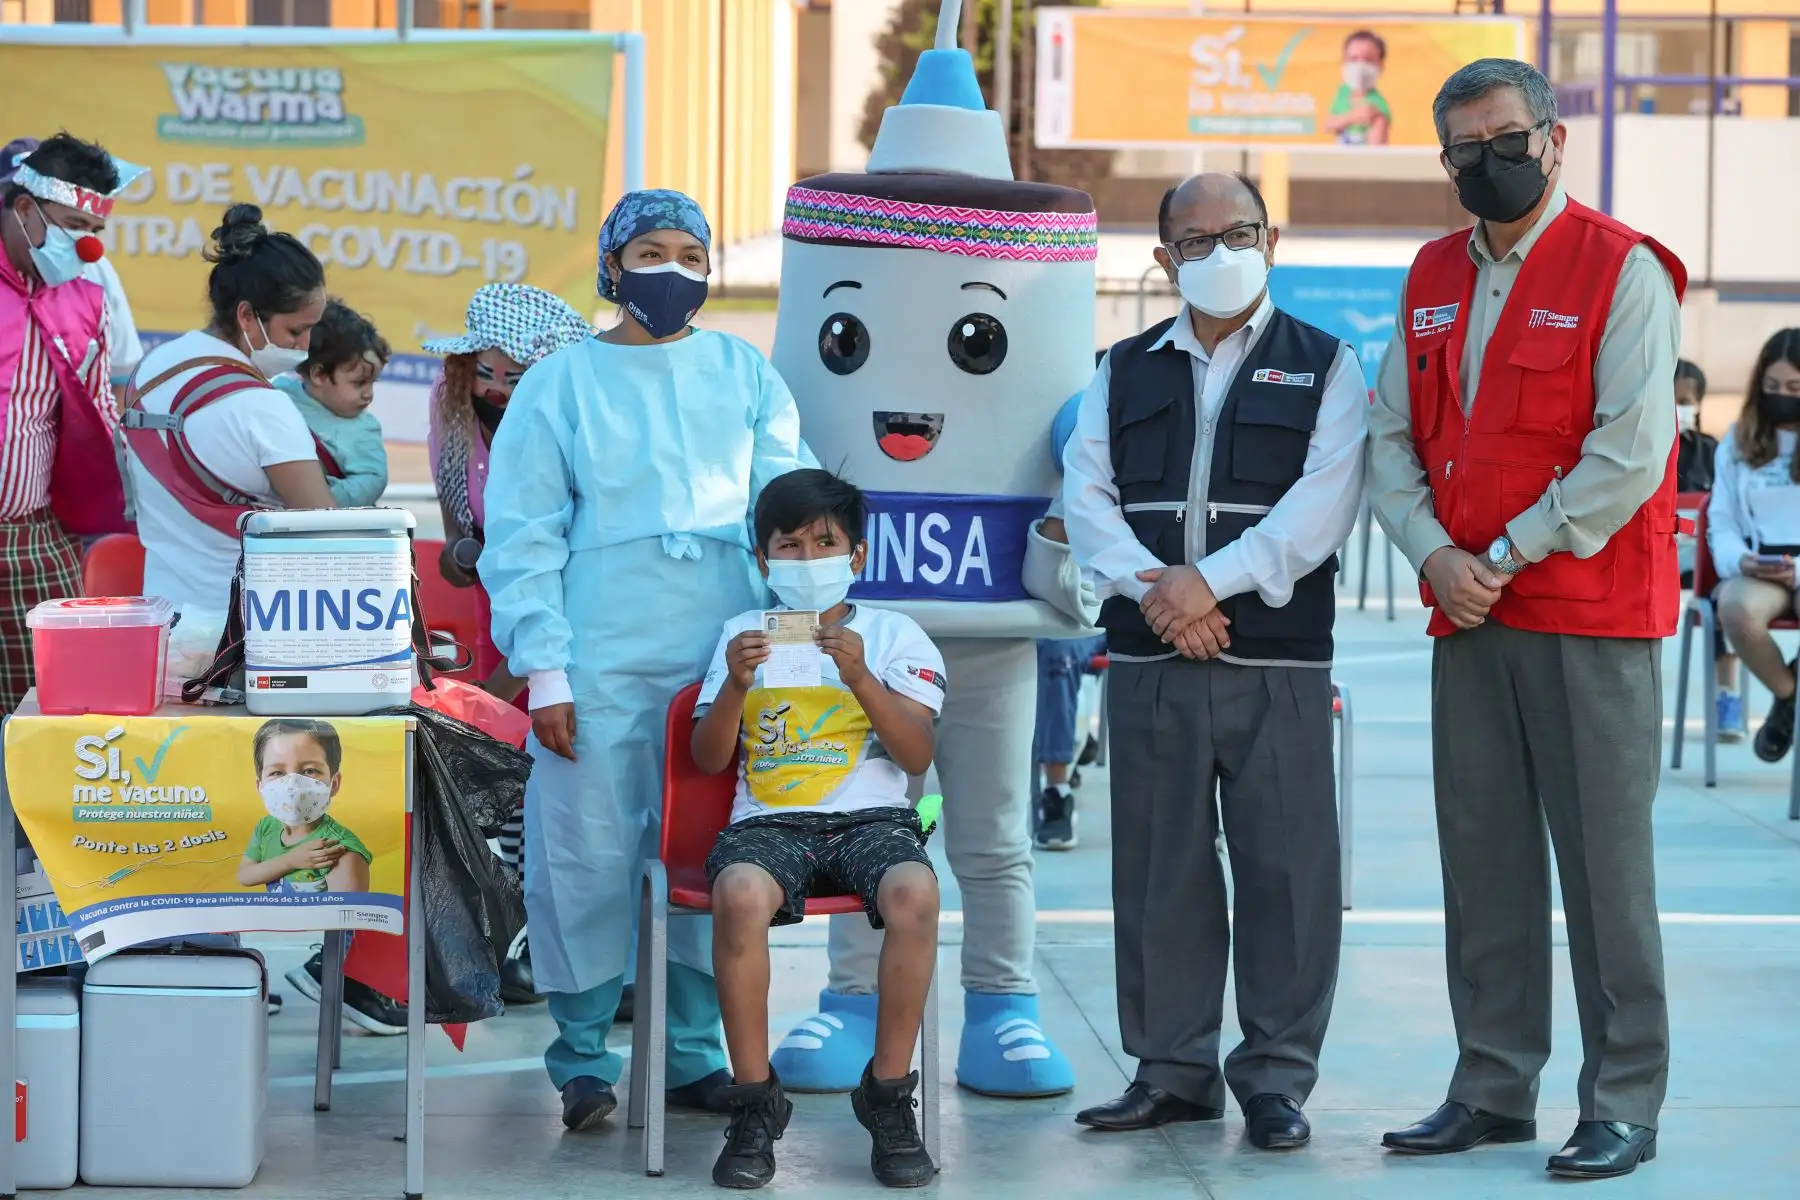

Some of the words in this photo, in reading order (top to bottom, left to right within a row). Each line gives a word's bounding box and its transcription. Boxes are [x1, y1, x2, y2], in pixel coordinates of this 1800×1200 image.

[172, 87, 346, 122] Warma
[166, 162, 233, 206] DE
[243, 163, 578, 232] VACUNACIÓN
[300, 222, 529, 282] COVID-19
[855, 512, 993, 587] INSA
[246, 588, 412, 632] MINSA
[74, 725, 131, 785] Sí,
[73, 784, 113, 804] me
[119, 784, 210, 805] vacuno.
[78, 808, 124, 821] Protege
[126, 809, 171, 820] nuestra
[173, 808, 206, 820] niñez
[73, 834, 129, 855] Ponte
[134, 842, 161, 854] las
[164, 840, 177, 852] 2
[180, 829, 227, 849] dosis
[80, 907, 108, 922] Vacuna
[109, 901, 139, 912] contra
[141, 899, 150, 907] la
[151, 896, 194, 906] COVID-19
[195, 897, 217, 905] para
[219, 895, 244, 903] niñas
[246, 896, 252, 904] y
[254, 895, 279, 903] niños
[281, 895, 293, 903] de
[356, 911, 389, 920] Siempre
